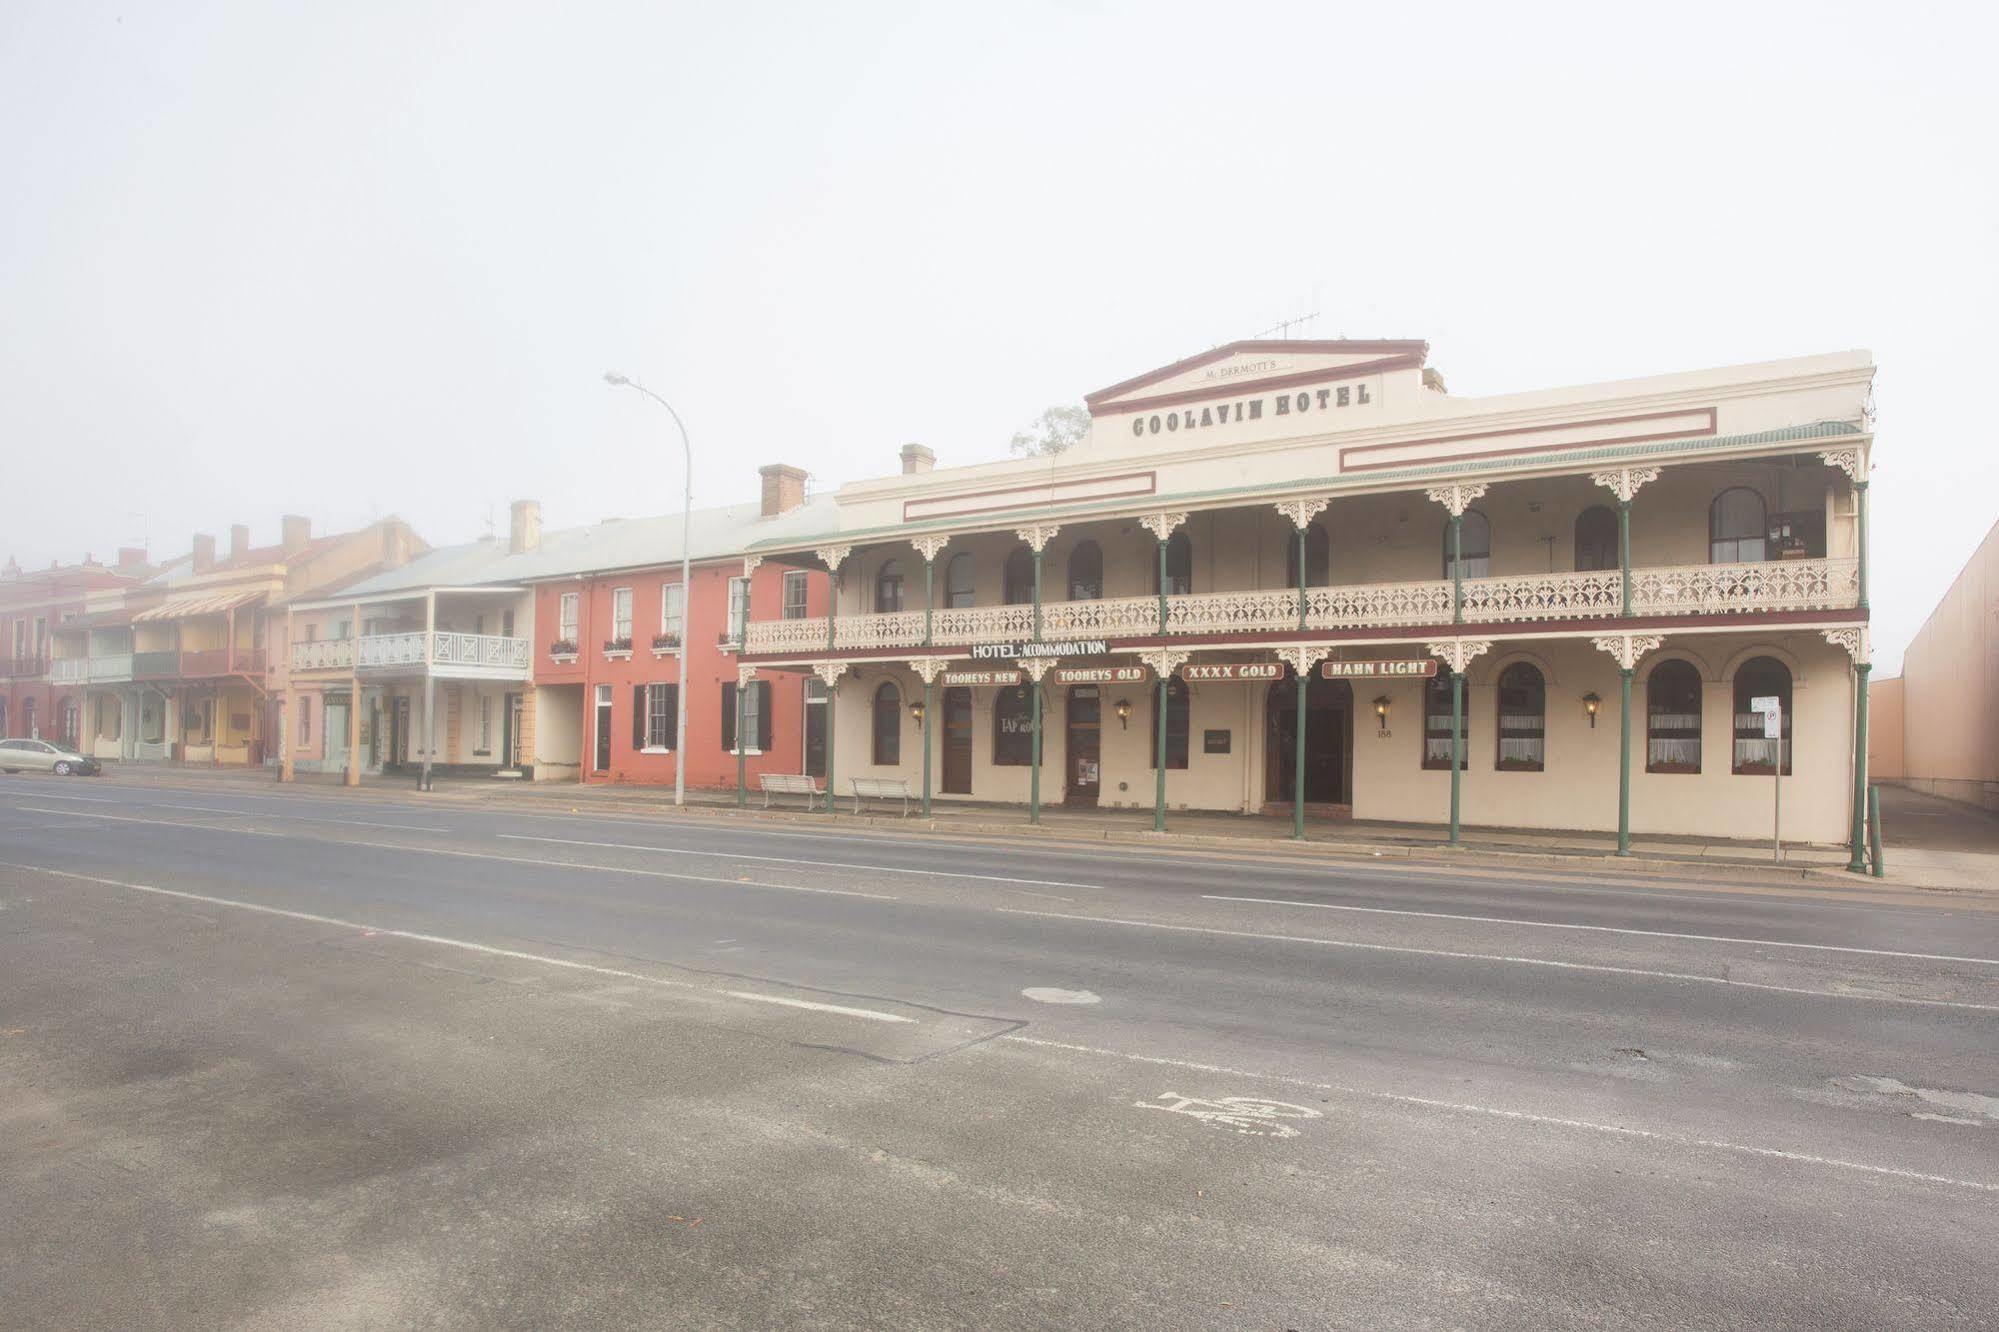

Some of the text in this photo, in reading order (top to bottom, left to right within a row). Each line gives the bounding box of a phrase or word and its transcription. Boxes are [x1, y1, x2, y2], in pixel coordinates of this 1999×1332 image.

[1276, 384, 1370, 415] HOTEL
[972, 640, 1106, 659] HOTEL ACCOMMODATION
[1059, 668, 1141, 682] TOOHEYS OLD
[1189, 665, 1277, 678] XXXX GOLD
[1332, 661, 1427, 675] HAHN LIGHT
[945, 672, 1018, 684] TOOHEYS NEW
[1001, 718, 1018, 733] TAP
